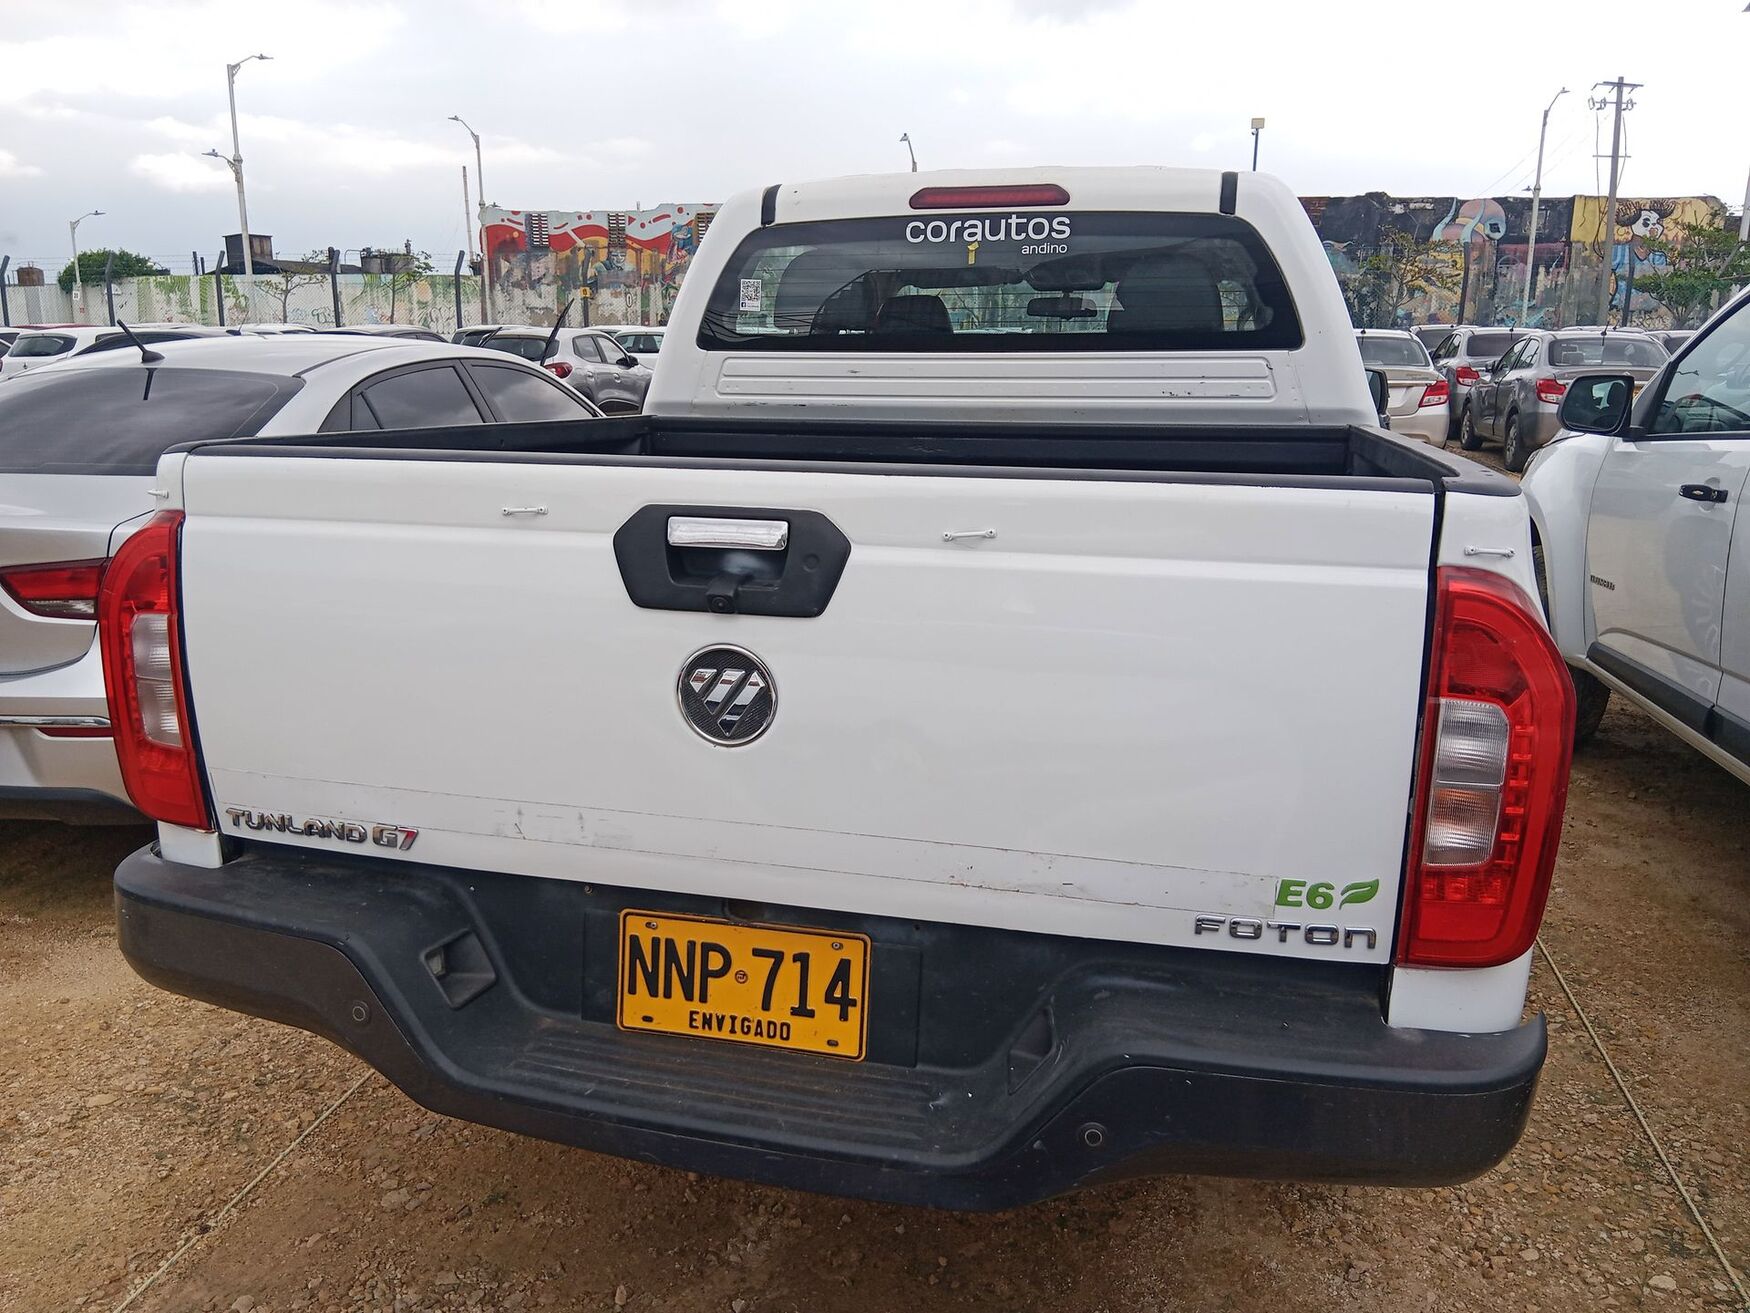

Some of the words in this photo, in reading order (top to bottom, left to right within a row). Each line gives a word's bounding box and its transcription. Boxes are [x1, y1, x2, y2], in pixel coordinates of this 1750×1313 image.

[905, 214, 1071, 243] corautos
[1021, 242, 1068, 255] andino
[225, 807, 368, 843] TUNLAND
[372, 823, 419, 851] G7
[1275, 878, 1336, 910] E6
[1194, 914, 1377, 950] FOTON
[627, 933, 733, 1004] NNP
[751, 947, 858, 1022] 714
[688, 1010, 792, 1042] ENVIGADO
